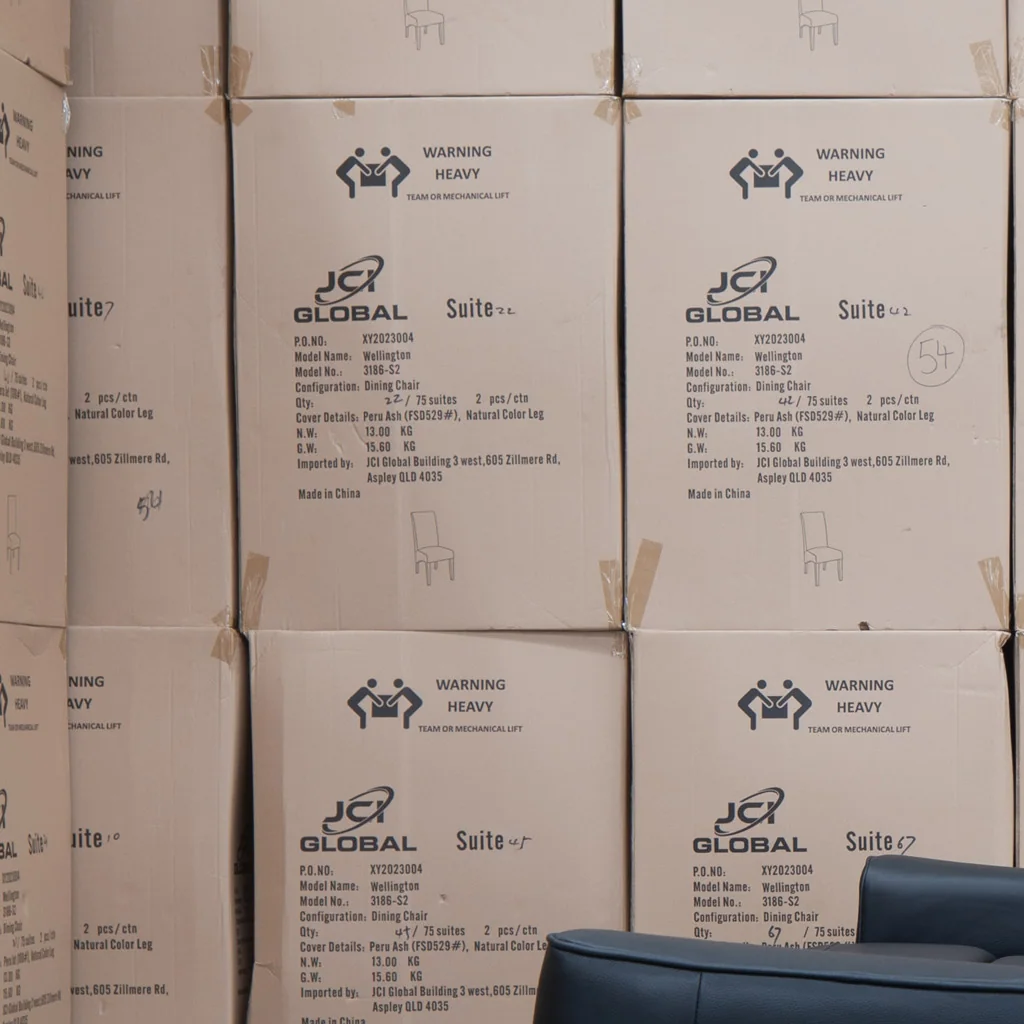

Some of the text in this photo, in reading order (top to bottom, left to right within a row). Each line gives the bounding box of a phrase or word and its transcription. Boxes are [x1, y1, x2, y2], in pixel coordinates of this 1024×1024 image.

[13, 109, 33, 132] WARNING
[16, 136, 30, 152] HEAVY
[66, 144, 102, 158] NING
[423, 146, 491, 158] WARNING
[816, 148, 884, 160] WARNING
[436, 168, 480, 180] HEAVY
[829, 170, 873, 181] HEAVY
[68, 297, 103, 318] uite
[294, 304, 408, 323] GLOBAL
[447, 298, 493, 319] Suite
[839, 299, 885, 320] Suite
[686, 306, 800, 323] GLOBAL
[363, 332, 414, 344] XY2023004
[295, 350, 411, 362] Model Name: Wellington
[919, 338, 955, 376] 54
[295, 366, 322, 377] Model
[364, 364, 400, 375] 3186-S2
[295, 380, 420, 394] Configuration: Dining Chair
[84, 392, 90, 403] 2
[74, 407, 153, 420] Natural Color Leg
[687, 413, 712, 423] Cover
[715, 412, 749, 422] Details:
[754, 412, 774, 422] Peru
[777, 411, 792, 422] Ash
[857, 410, 890, 421] Natural
[893, 410, 916, 421] Color
[919, 410, 934, 422] Leg
[114, 453, 152, 464] Zillmere
[10, 675, 31, 687] WARNING
[68, 676, 104, 688] NING
[436, 679, 505, 690] WARNING
[825, 680, 893, 691] WARNING
[15, 698, 28, 710] HEAVY
[448, 701, 493, 712] HEAVY
[838, 702, 882, 713] HEAVY
[300, 835, 417, 852] GLOBAL
[457, 830, 503, 851] Suite
[693, 836, 807, 853] GLOBAL
[846, 831, 892, 851] Suite
[693, 881, 810, 894] Model Name: Wellington
[694, 897, 720, 907] Model
[763, 896, 799, 907] 3186-S2
[300, 911, 428, 924] Configuration: Dining Chair
[84, 923, 89, 934] 2
[74, 938, 153, 951] Natural Color Leg
[113, 984, 151, 995] Zillmere
